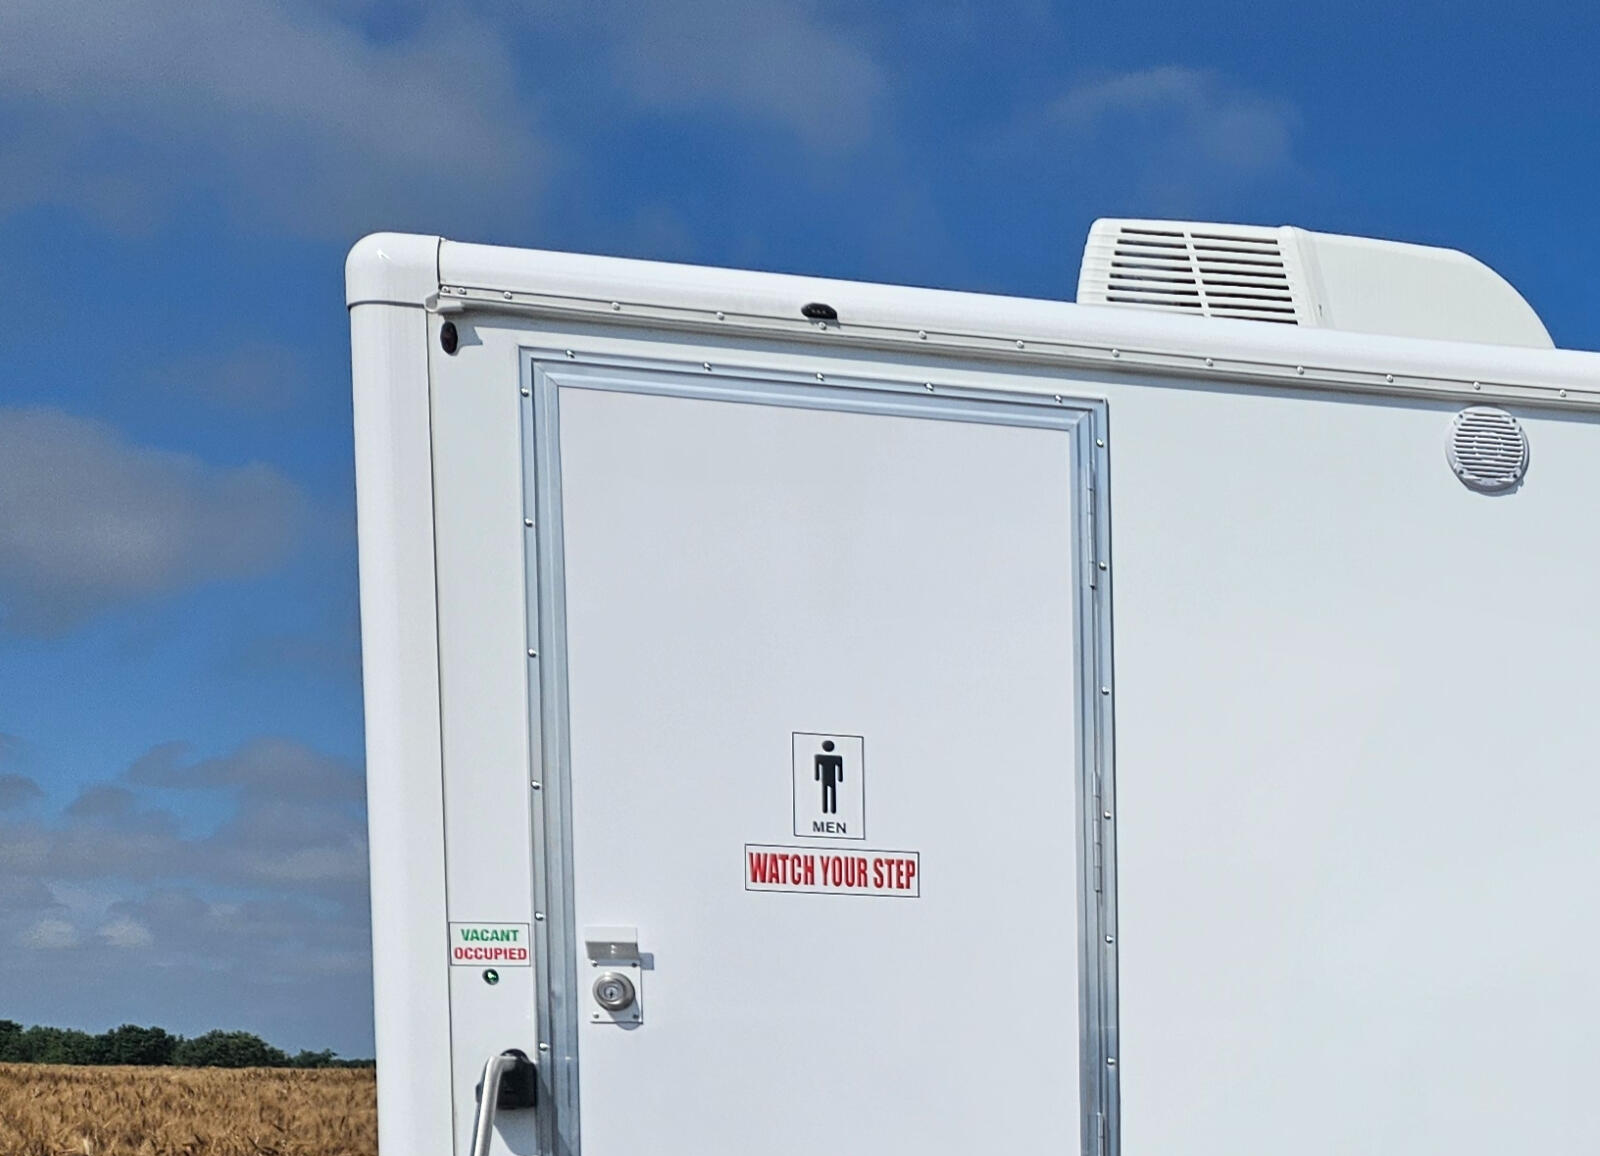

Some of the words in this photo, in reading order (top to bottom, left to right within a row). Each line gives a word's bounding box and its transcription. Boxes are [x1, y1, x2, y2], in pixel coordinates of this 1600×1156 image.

[812, 820, 847, 834] MEN
[748, 852, 815, 886] WATCH
[820, 855, 868, 888] YOUR
[873, 858, 916, 889] STEP
[461, 929, 519, 942] VACANT
[454, 947, 528, 961] OCCUPIED
